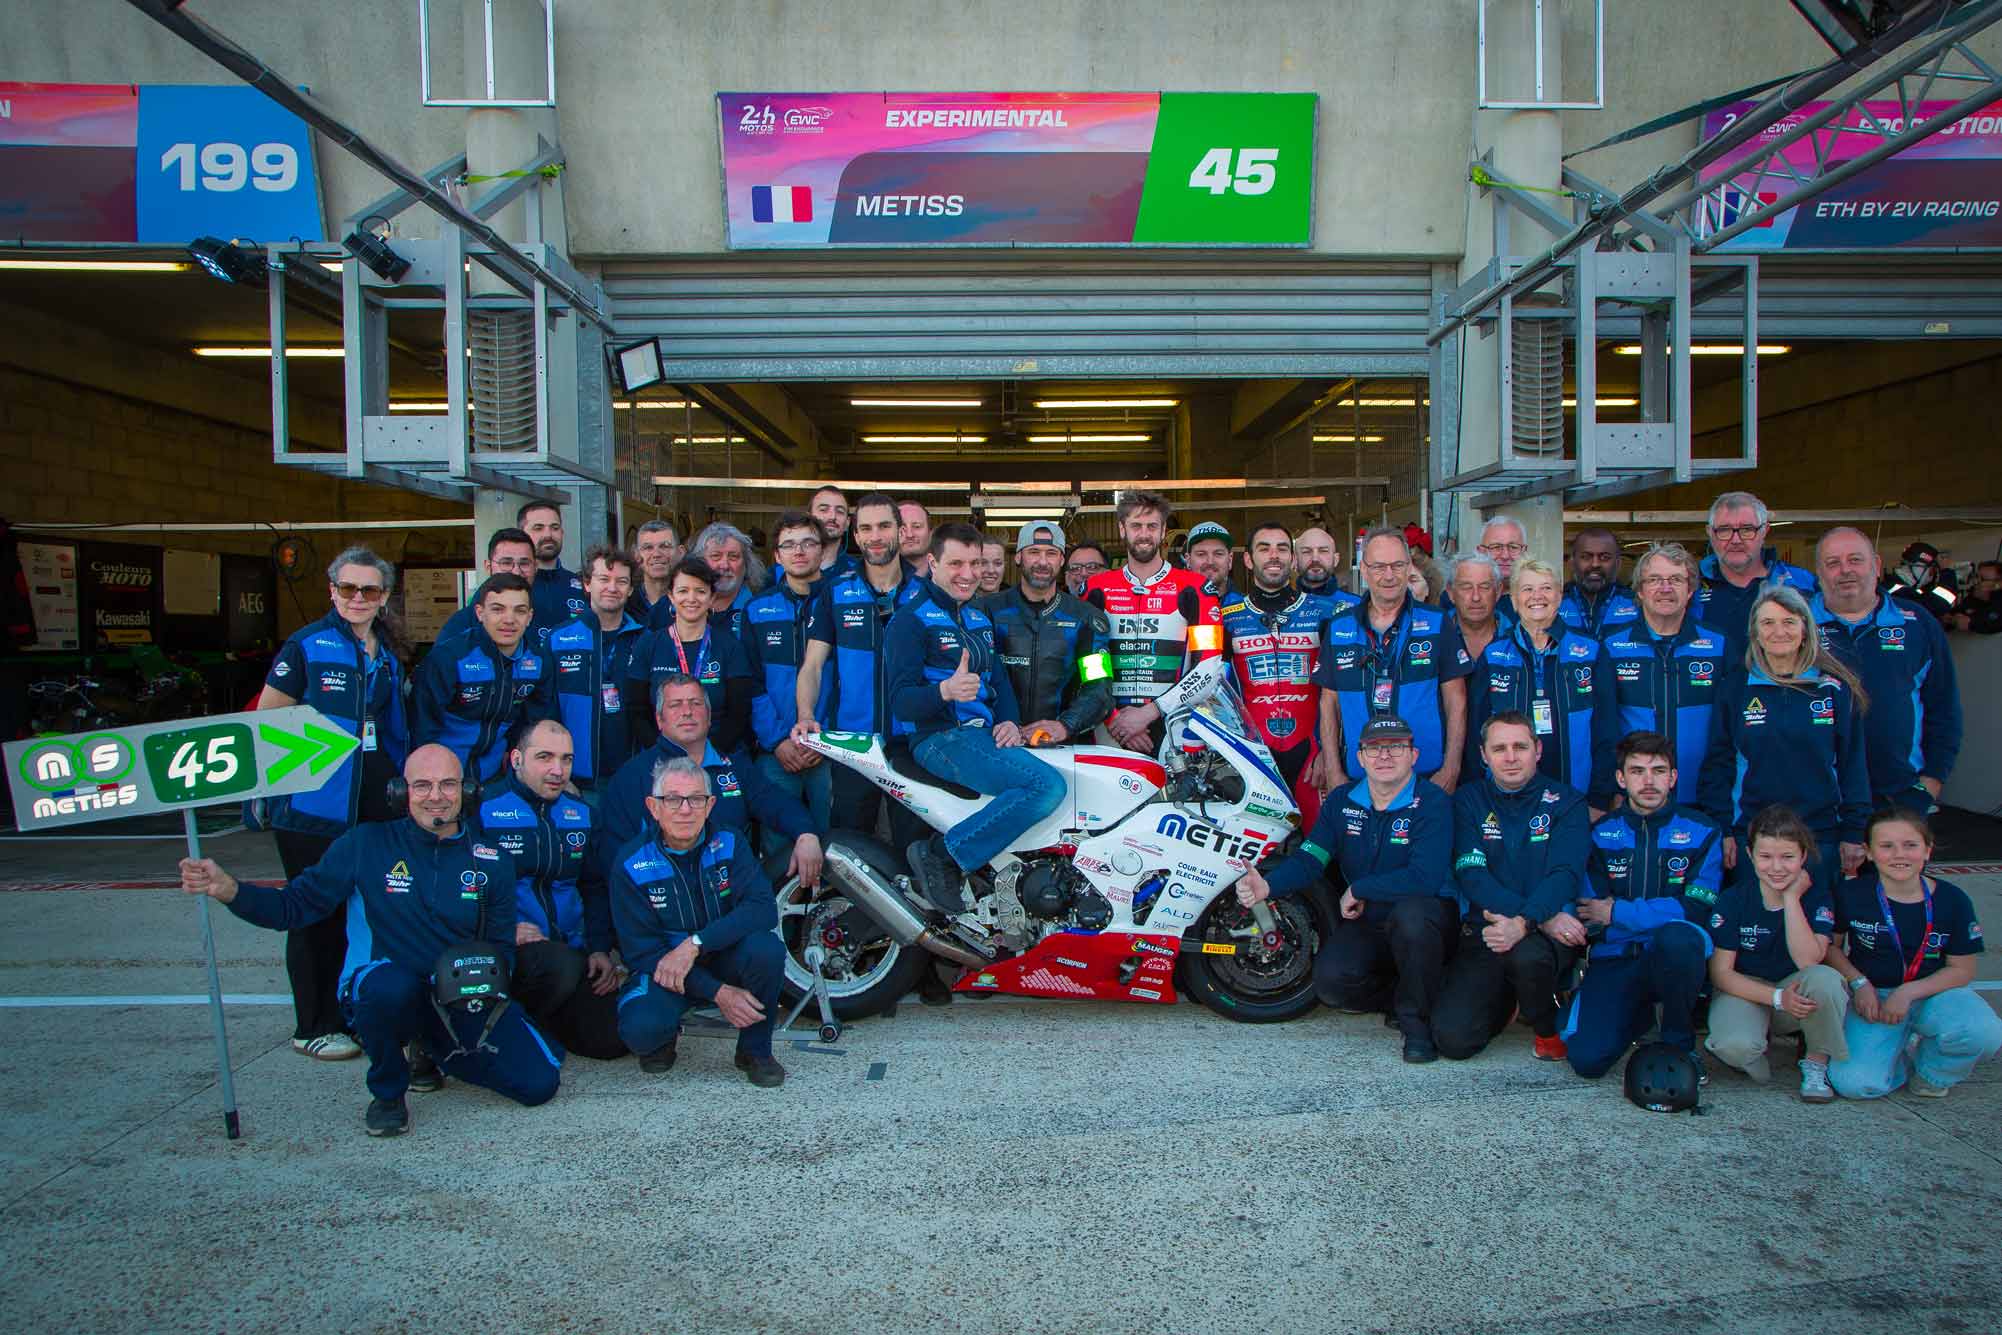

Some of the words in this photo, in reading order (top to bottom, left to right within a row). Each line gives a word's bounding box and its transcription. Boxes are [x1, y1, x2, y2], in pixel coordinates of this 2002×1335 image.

[790, 115, 820, 125] EWC
[885, 110, 1068, 128] EXPERIMENTAL
[739, 124, 775, 132] MOTOS
[160, 142, 299, 192] 199
[1188, 146, 1279, 196] 45
[855, 195, 964, 217] METISS
[1815, 201, 1857, 217] ETH
[1860, 201, 1890, 217] BY
[1891, 201, 1922, 217] 2V
[1923, 200, 2000, 217] RACING
[98, 573, 152, 586] MOTO
[238, 592, 265, 615] AEG
[1147, 597, 1162, 609] CTR
[96, 609, 151, 626] Kawasaki
[1119, 640, 1150, 651] elacin
[1238, 636, 1312, 650] HONDA
[91, 743, 121, 773] S
[167, 735, 239, 788] 45
[1251, 791, 1271, 802] DELTA
[492, 809, 516, 818] elacin
[499, 834, 524, 842] ALD
[1177, 862, 1197, 874] COUR
[1200, 868, 1219, 880] EAUX
[1175, 870, 1216, 888] ELECTRICITE
[1160, 907, 1194, 920] ALD
[1056, 956, 1088, 969] SCORPION
